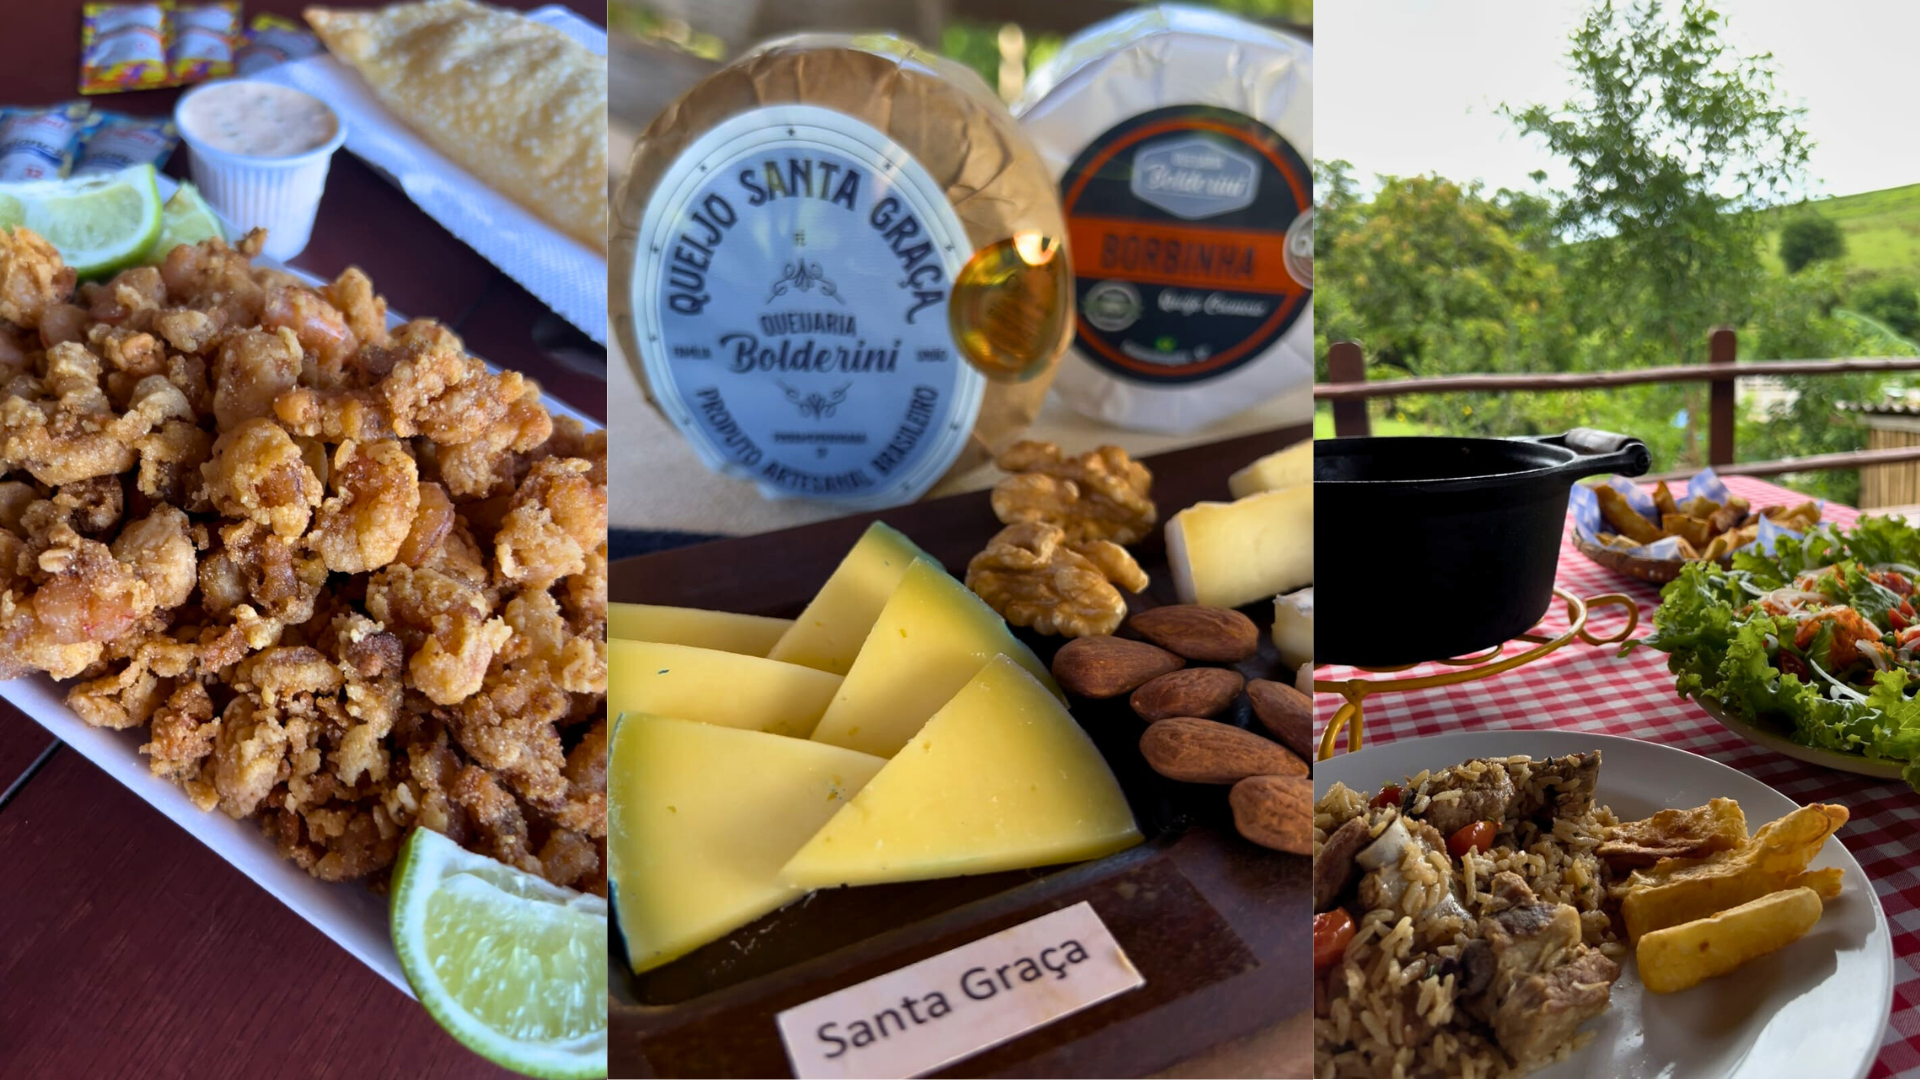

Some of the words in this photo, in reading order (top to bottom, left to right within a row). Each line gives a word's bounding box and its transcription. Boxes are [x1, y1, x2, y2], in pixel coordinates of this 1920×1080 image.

[670, 193, 738, 316] QUEIJO
[739, 158, 860, 211] SANTA
[869, 196, 945, 325] GRAÇA
[1102, 234, 1255, 279] BORBINHA
[718, 331, 901, 374] Bolderini
[697, 387, 763, 466] PRODUTO
[762, 461, 875, 494] ARTESANAL
[871, 384, 940, 477] BRASILEIRO
[816, 991, 952, 1059] Santa
[959, 938, 1090, 1001] Graça
